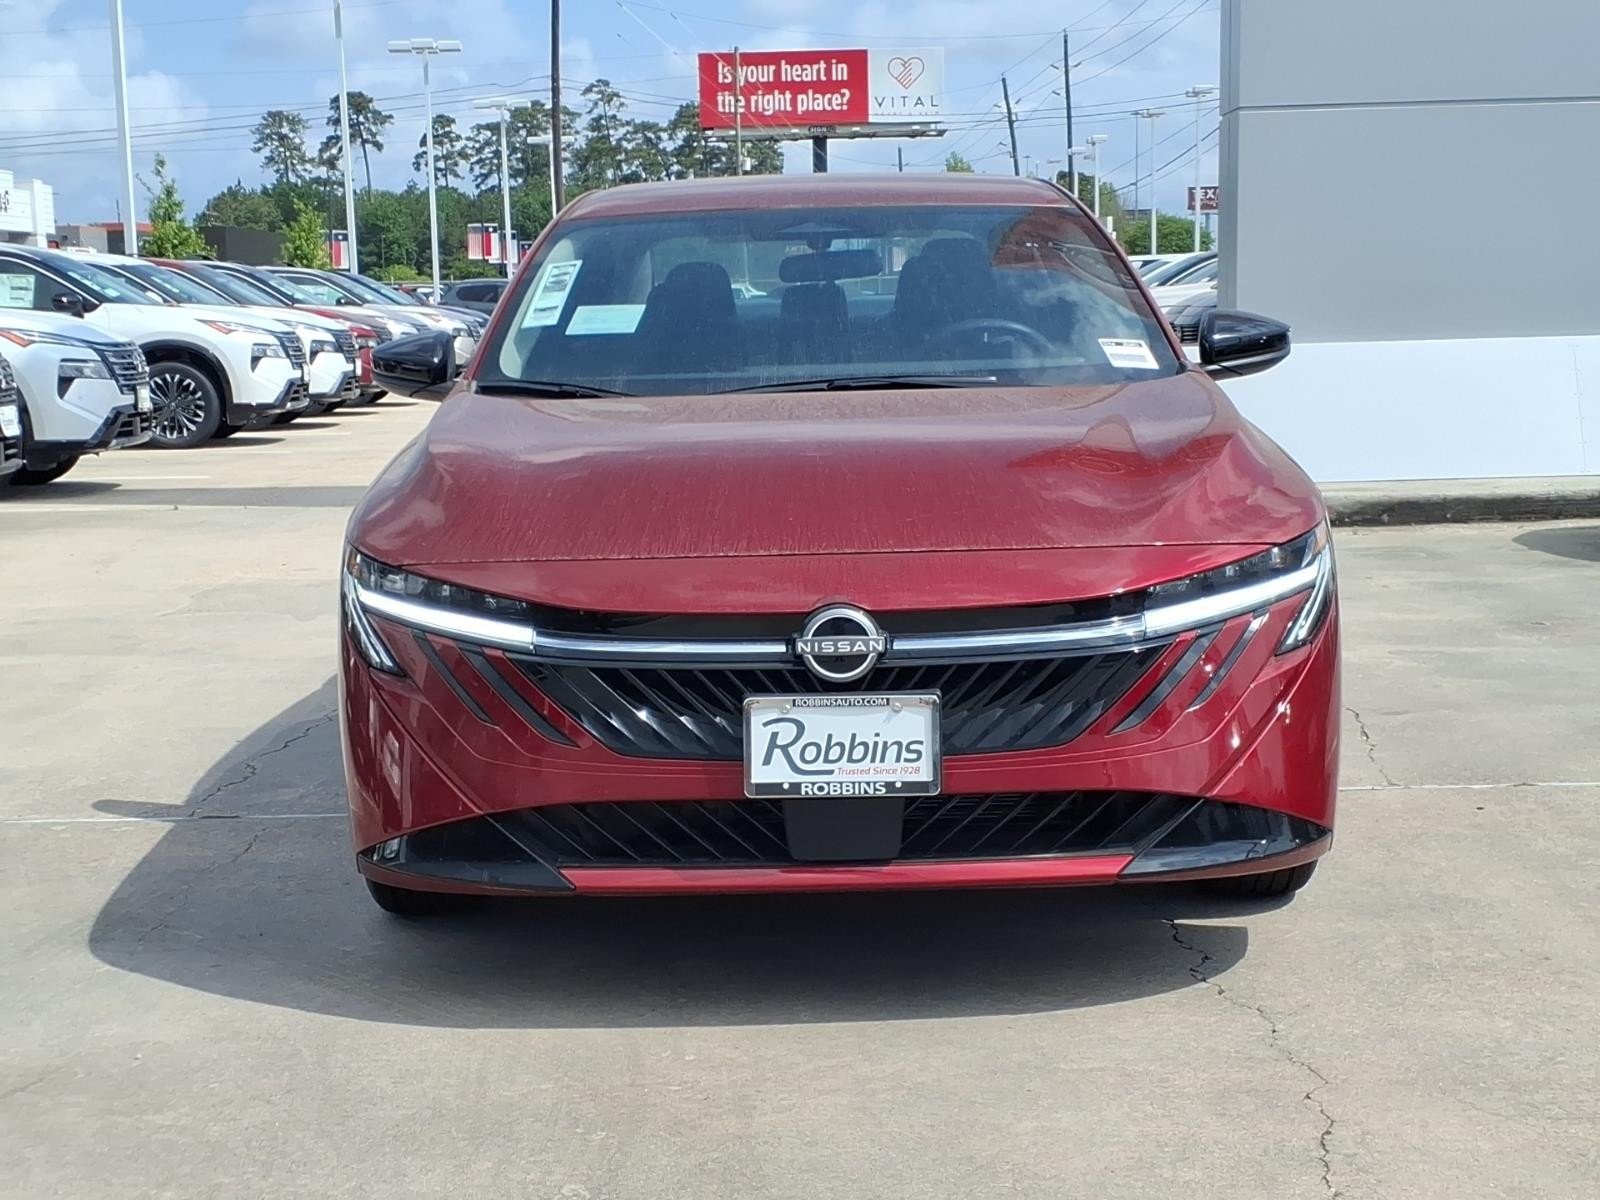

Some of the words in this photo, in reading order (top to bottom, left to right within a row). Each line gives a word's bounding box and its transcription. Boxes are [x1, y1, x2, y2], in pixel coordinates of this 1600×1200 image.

[718, 61, 732, 84] Is
[736, 64, 776, 86] your
[781, 59, 827, 82] heart
[832, 58, 848, 81] in
[717, 91, 745, 113] the
[750, 89, 792, 115] right
[797, 88, 850, 115] place?
[874, 95, 939, 108] VITAL
[797, 640, 883, 653] NISSAN
[795, 698, 887, 707] ROBBINSAUTO.COM
[761, 717, 924, 776] Robbins
[837, 767, 871, 776] Trusted
[873, 766, 898, 775] Since
[899, 766, 921, 775] 1928
[801, 782, 886, 796] ROBBINS
